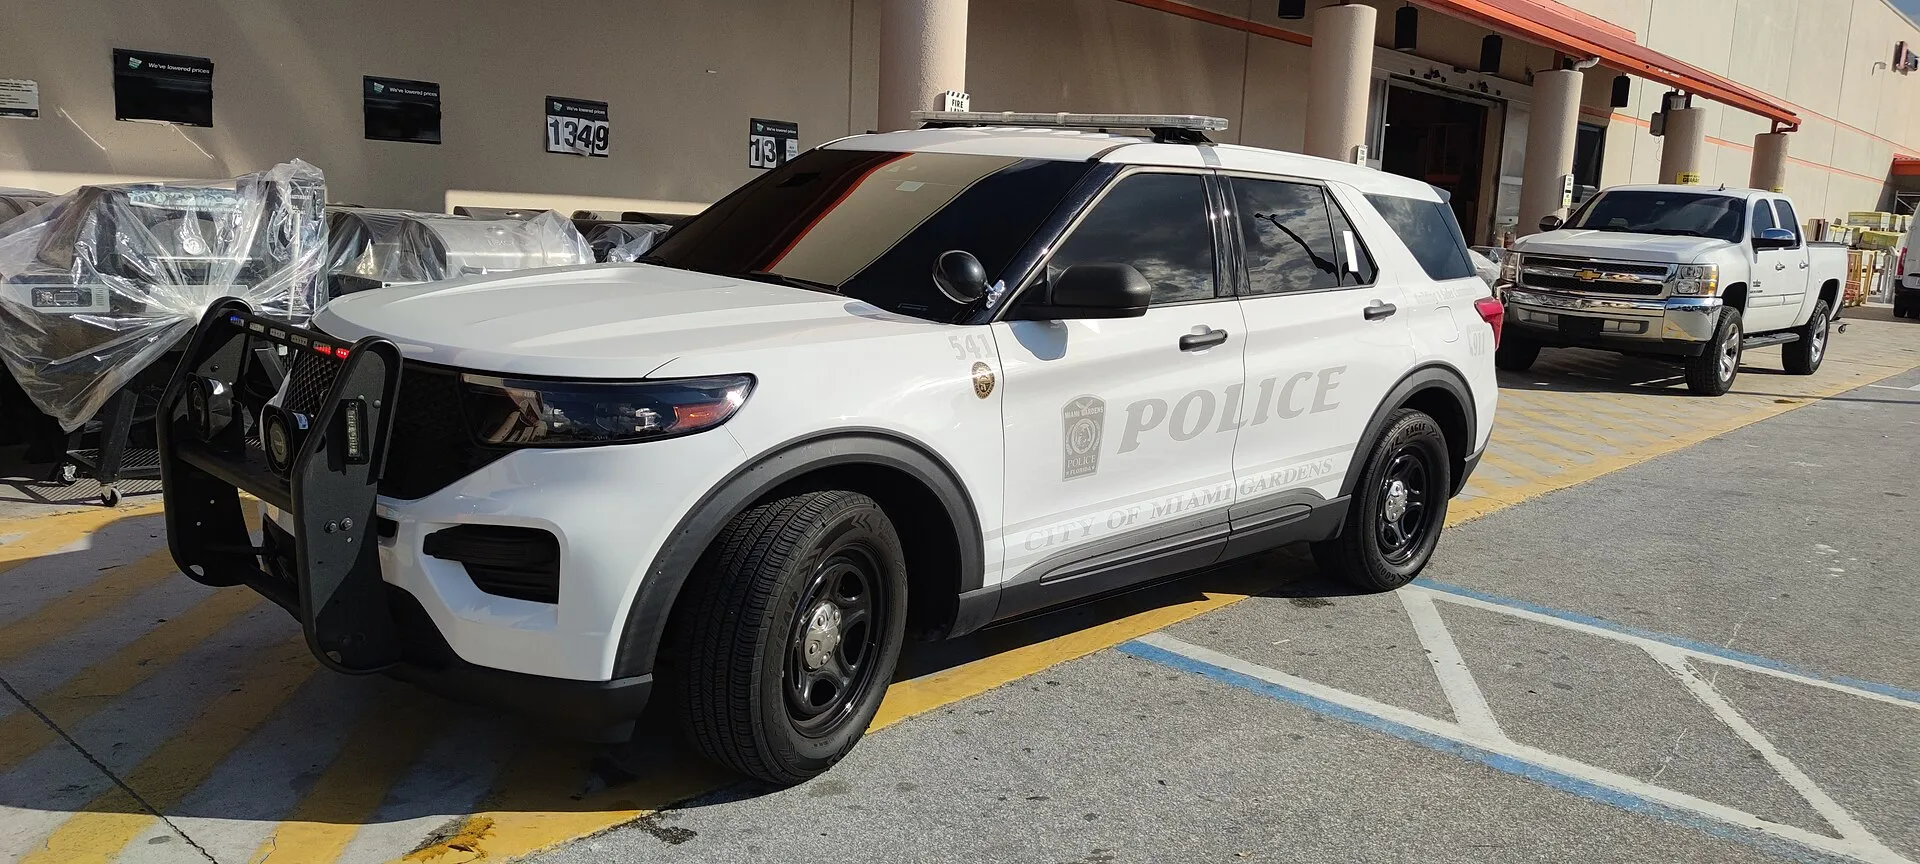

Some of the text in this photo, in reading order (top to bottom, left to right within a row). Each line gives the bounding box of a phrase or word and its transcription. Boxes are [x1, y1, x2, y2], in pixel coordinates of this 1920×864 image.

[148, 62, 166, 70] We've
[167, 64, 191, 72] lowered
[952, 99, 963, 108] FIRE
[549, 119, 609, 151] 1349
[948, 333, 996, 360] 541
[1116, 365, 1348, 455] POLICE
[1405, 422, 1427, 437] EAGLE
[1067, 455, 1096, 468] POLICE
[1024, 458, 1333, 552] CITY OF MIAMI GARDENS
